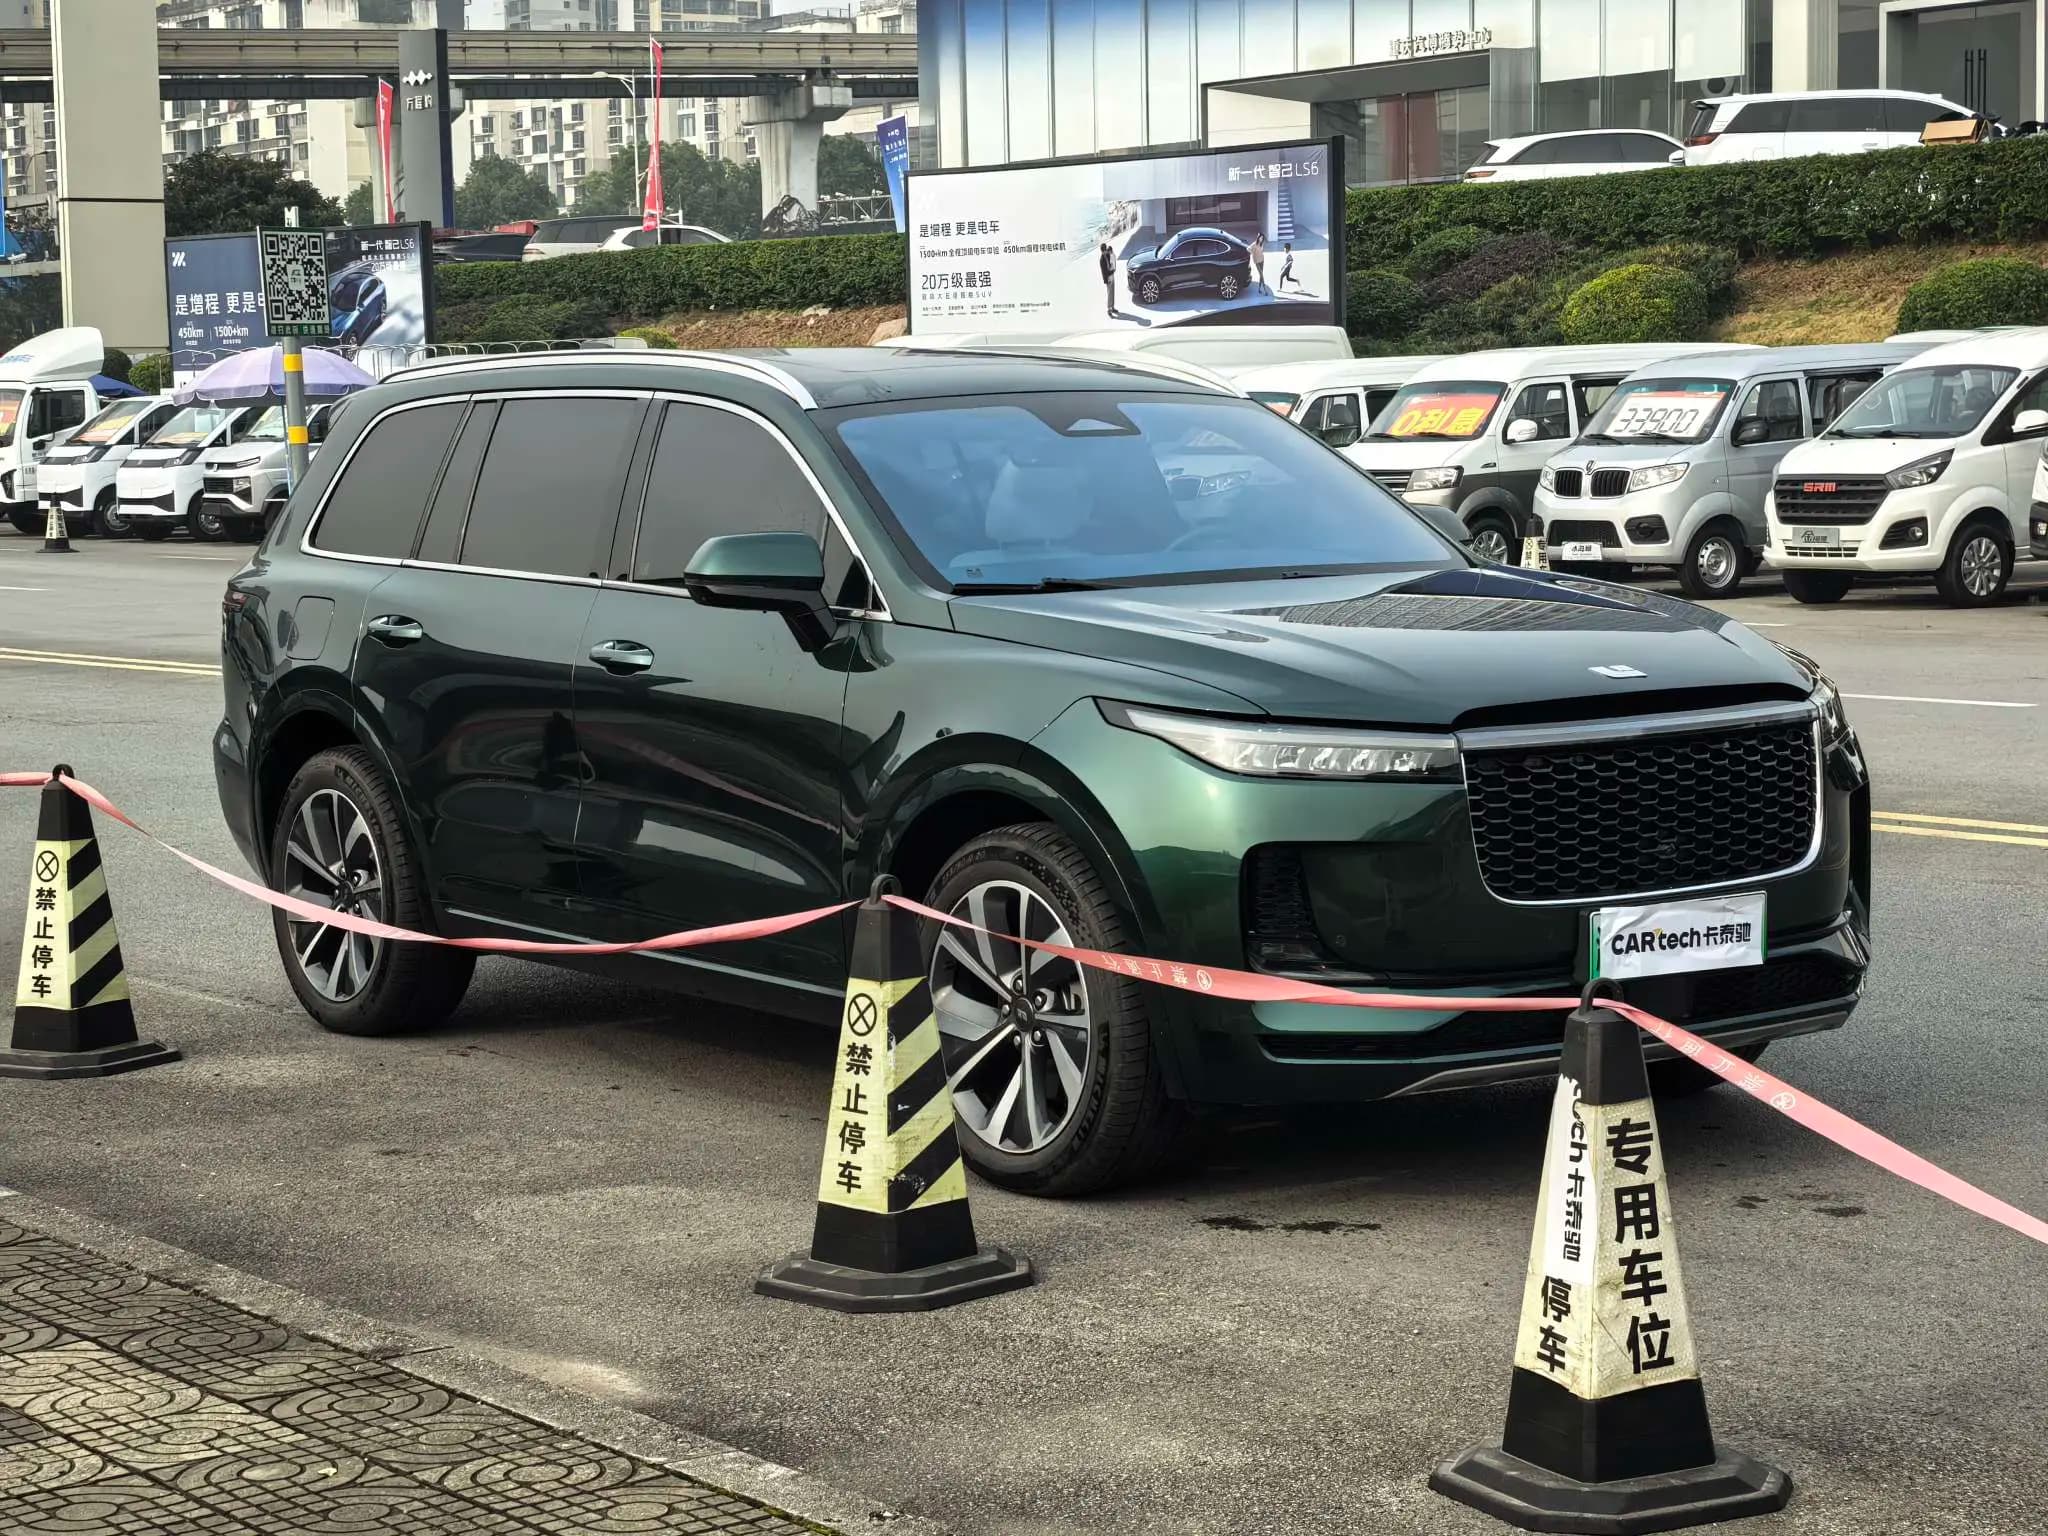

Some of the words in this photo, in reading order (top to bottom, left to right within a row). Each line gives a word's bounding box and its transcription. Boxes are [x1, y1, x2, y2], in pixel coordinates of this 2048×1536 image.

[1228, 164, 1266, 181] 新一代
[919, 223, 951, 238] 是增程
[955, 220, 1000, 236] 更是电车
[921, 270, 992, 290] 20万级最强
[175, 293, 220, 316] 是增程
[178, 325, 204, 338] 450km
[214, 323, 249, 337] 1500+km
[1613, 407, 1699, 434] 33900
[1803, 482, 1836, 492] SRM
[31, 887, 57, 998] 禁止停车
[836, 1042, 873, 1194] 禁止停车
[1605, 1118, 1675, 1374] 专用车位
[1536, 1275, 1572, 1372] 停车
